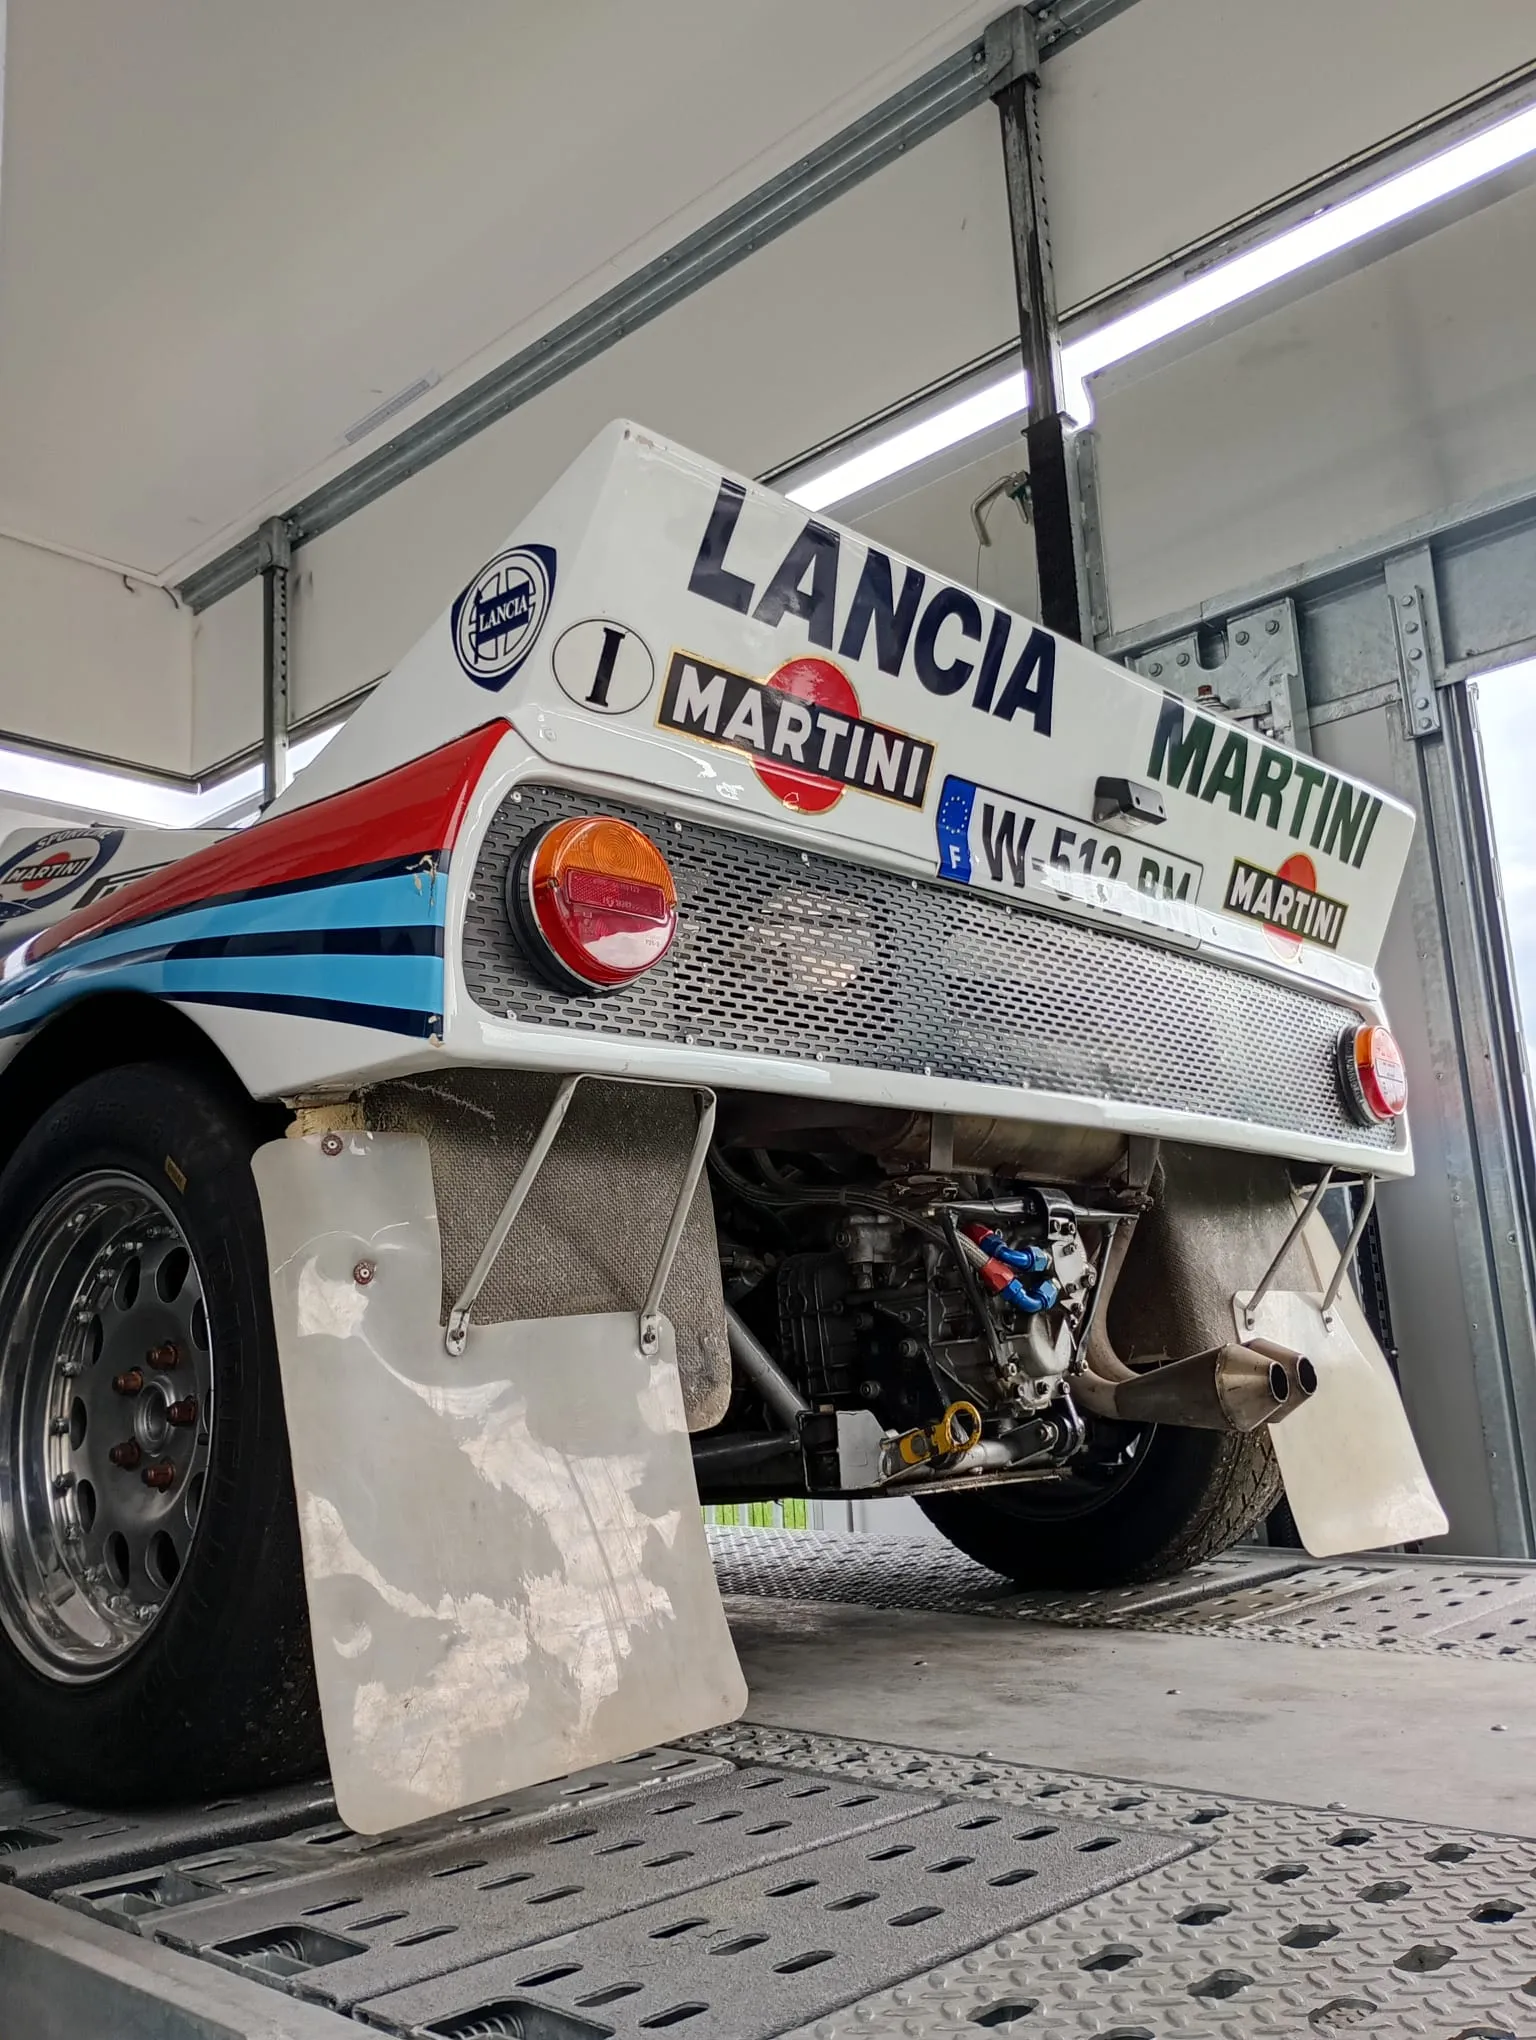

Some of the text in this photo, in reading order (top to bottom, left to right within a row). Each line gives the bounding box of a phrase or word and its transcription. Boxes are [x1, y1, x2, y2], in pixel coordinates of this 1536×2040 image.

[480, 594, 528, 632] LANCIA
[688, 477, 1057, 737] LANCIA
[585, 626, 626, 707] I
[672, 664, 924, 800] MARTINI
[1147, 691, 1383, 869] MARTINI
[7, 860, 86, 882] MARTINI
[949, 845, 961, 869] F
[1230, 865, 1346, 945] MARTINI
